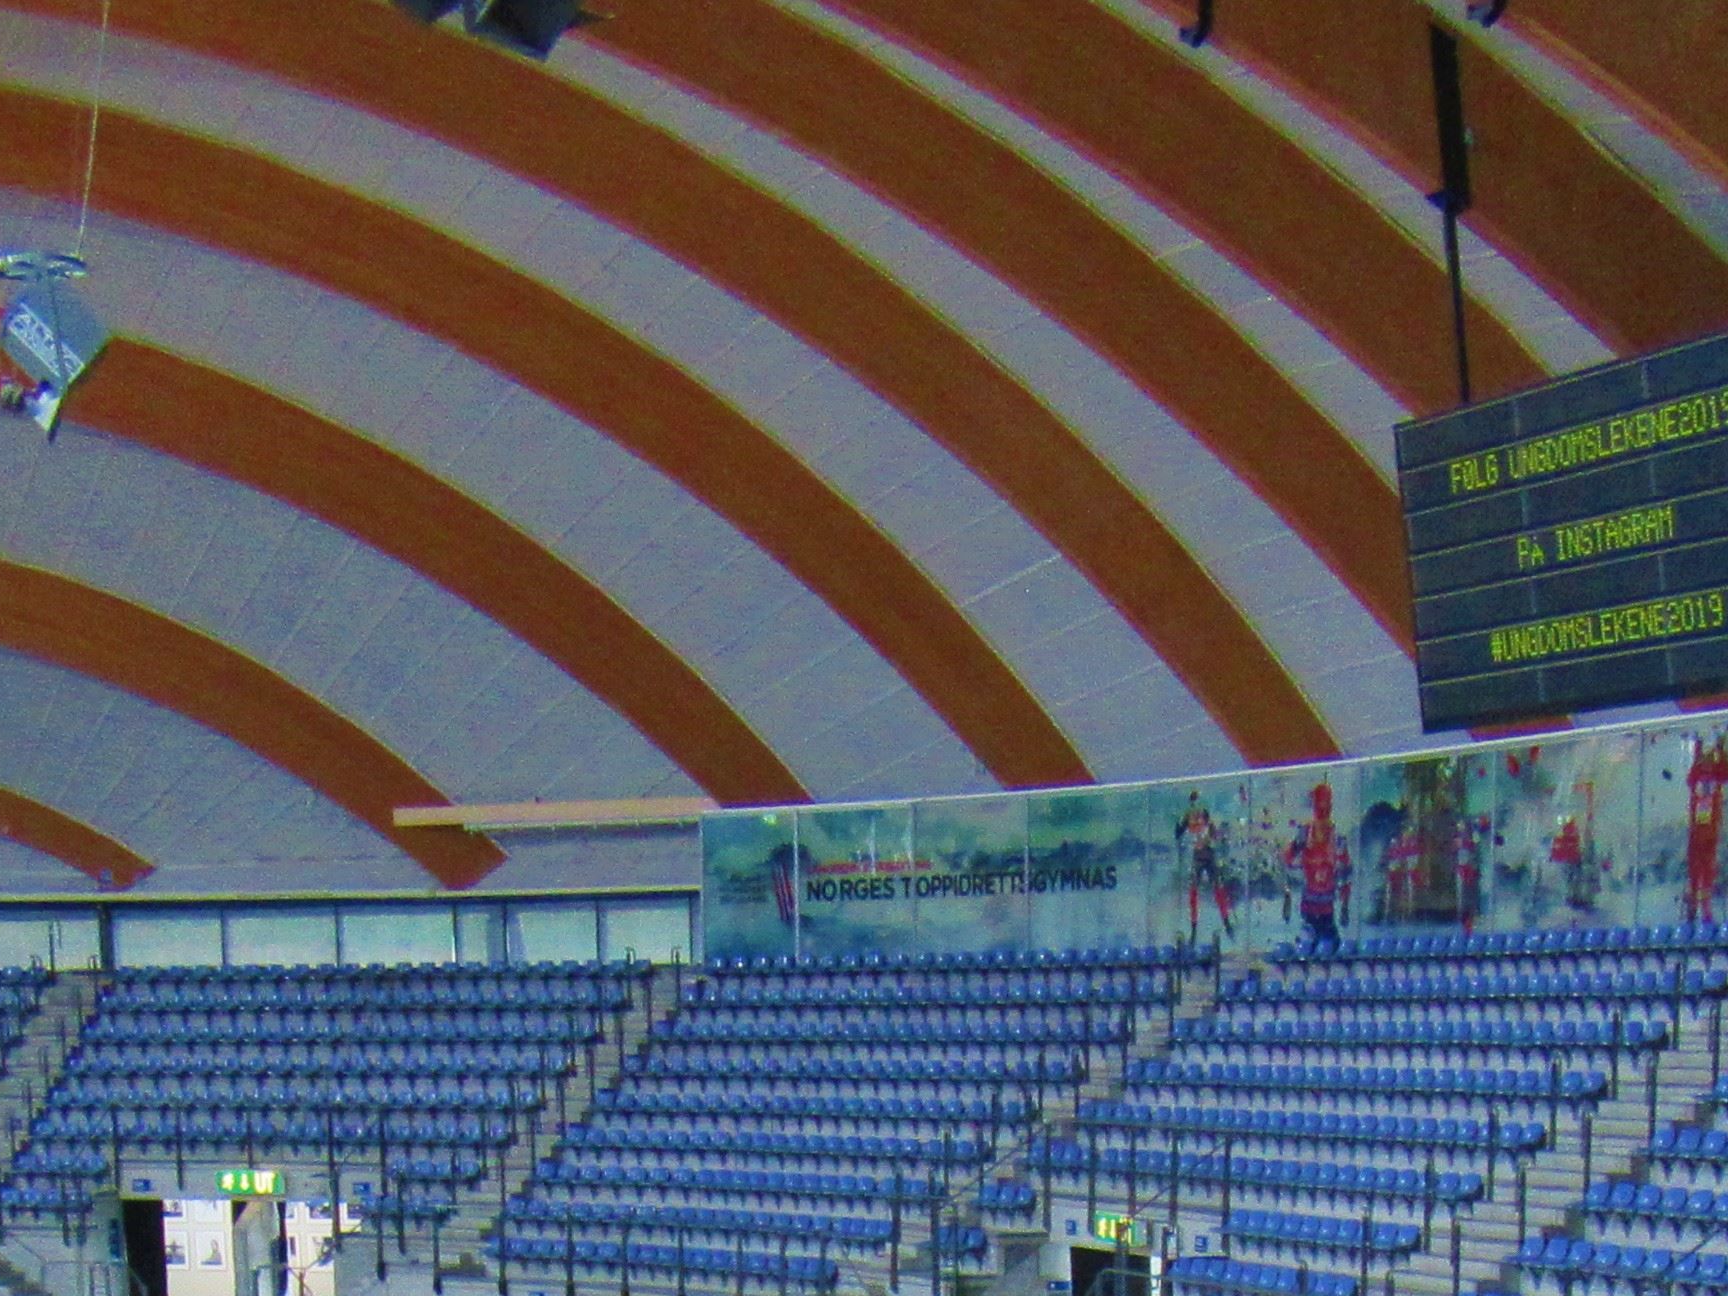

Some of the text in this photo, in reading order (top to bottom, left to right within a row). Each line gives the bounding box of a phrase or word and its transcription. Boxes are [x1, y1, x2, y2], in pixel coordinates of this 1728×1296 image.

[1554, 505, 1674, 562] INSTAGRAM
[1489, 592, 1725, 662] #UNGDOMSLEKENE2019
[806, 876, 896, 902] NORGES
